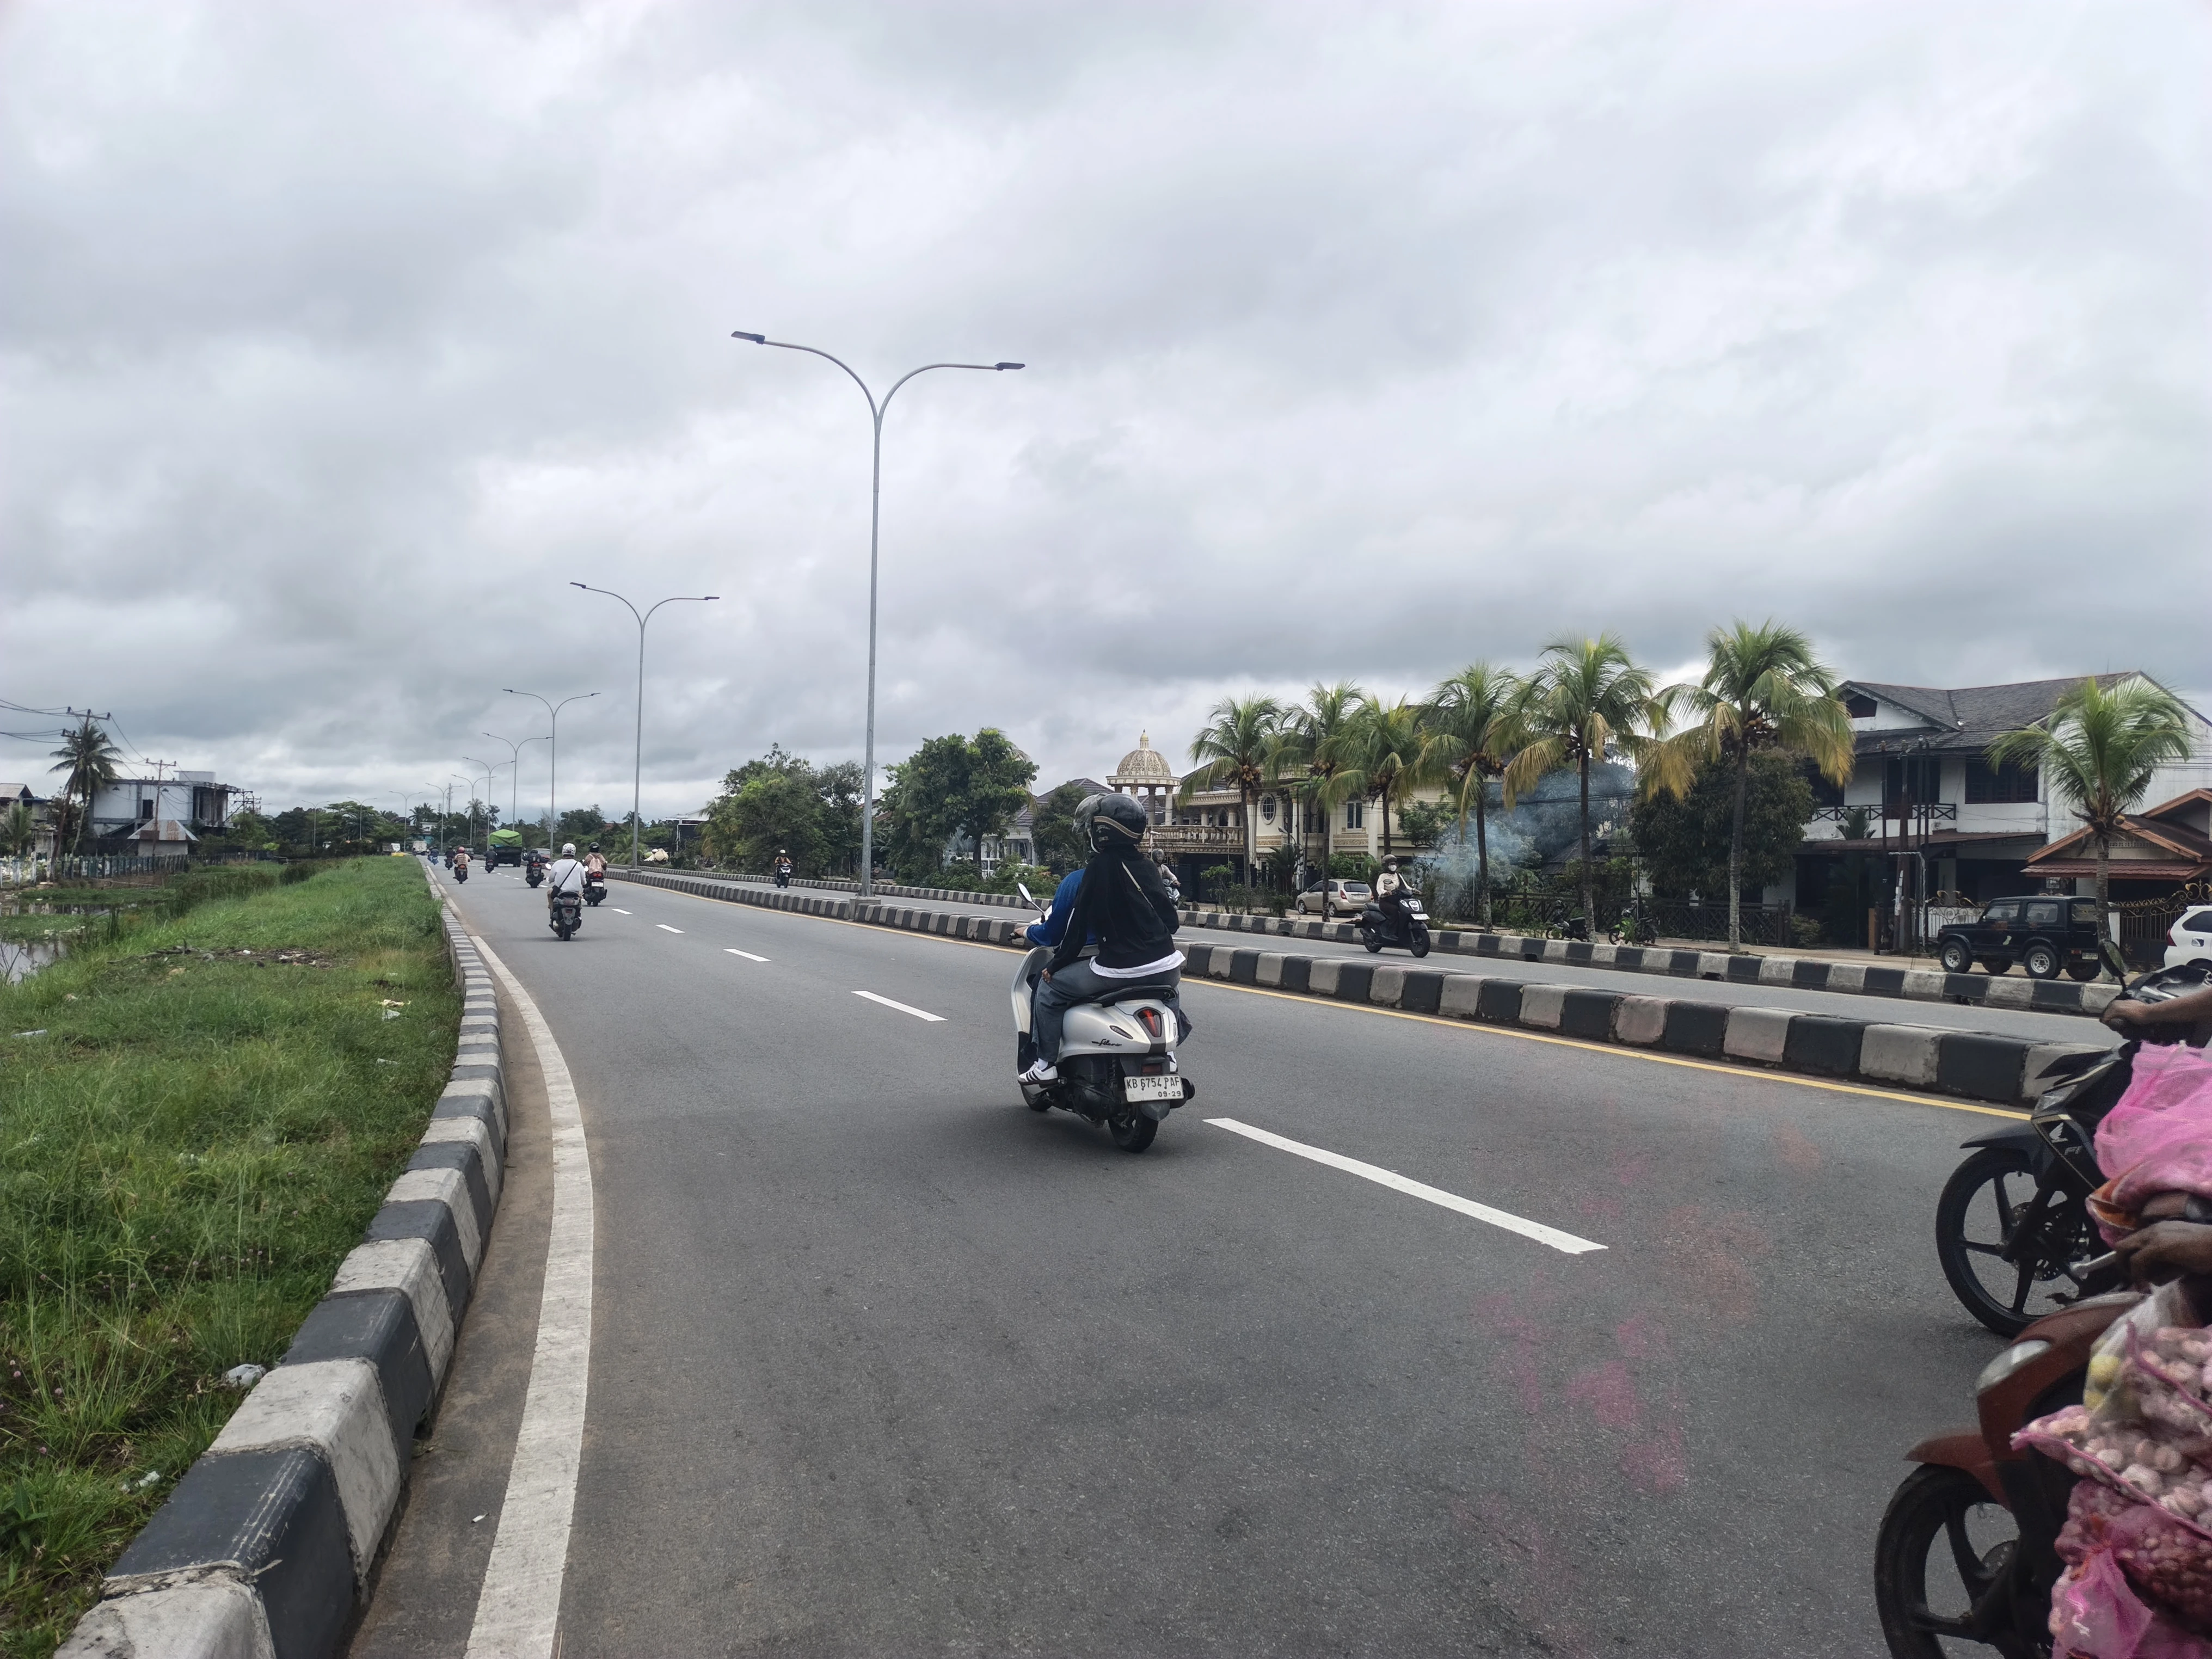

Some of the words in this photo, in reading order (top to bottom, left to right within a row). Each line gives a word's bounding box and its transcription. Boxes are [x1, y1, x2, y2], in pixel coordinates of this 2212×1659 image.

[1126, 1079, 1138, 1089] KB
[1140, 1078, 1162, 1088] 6754
[1164, 1077, 1179, 1089] PAF
